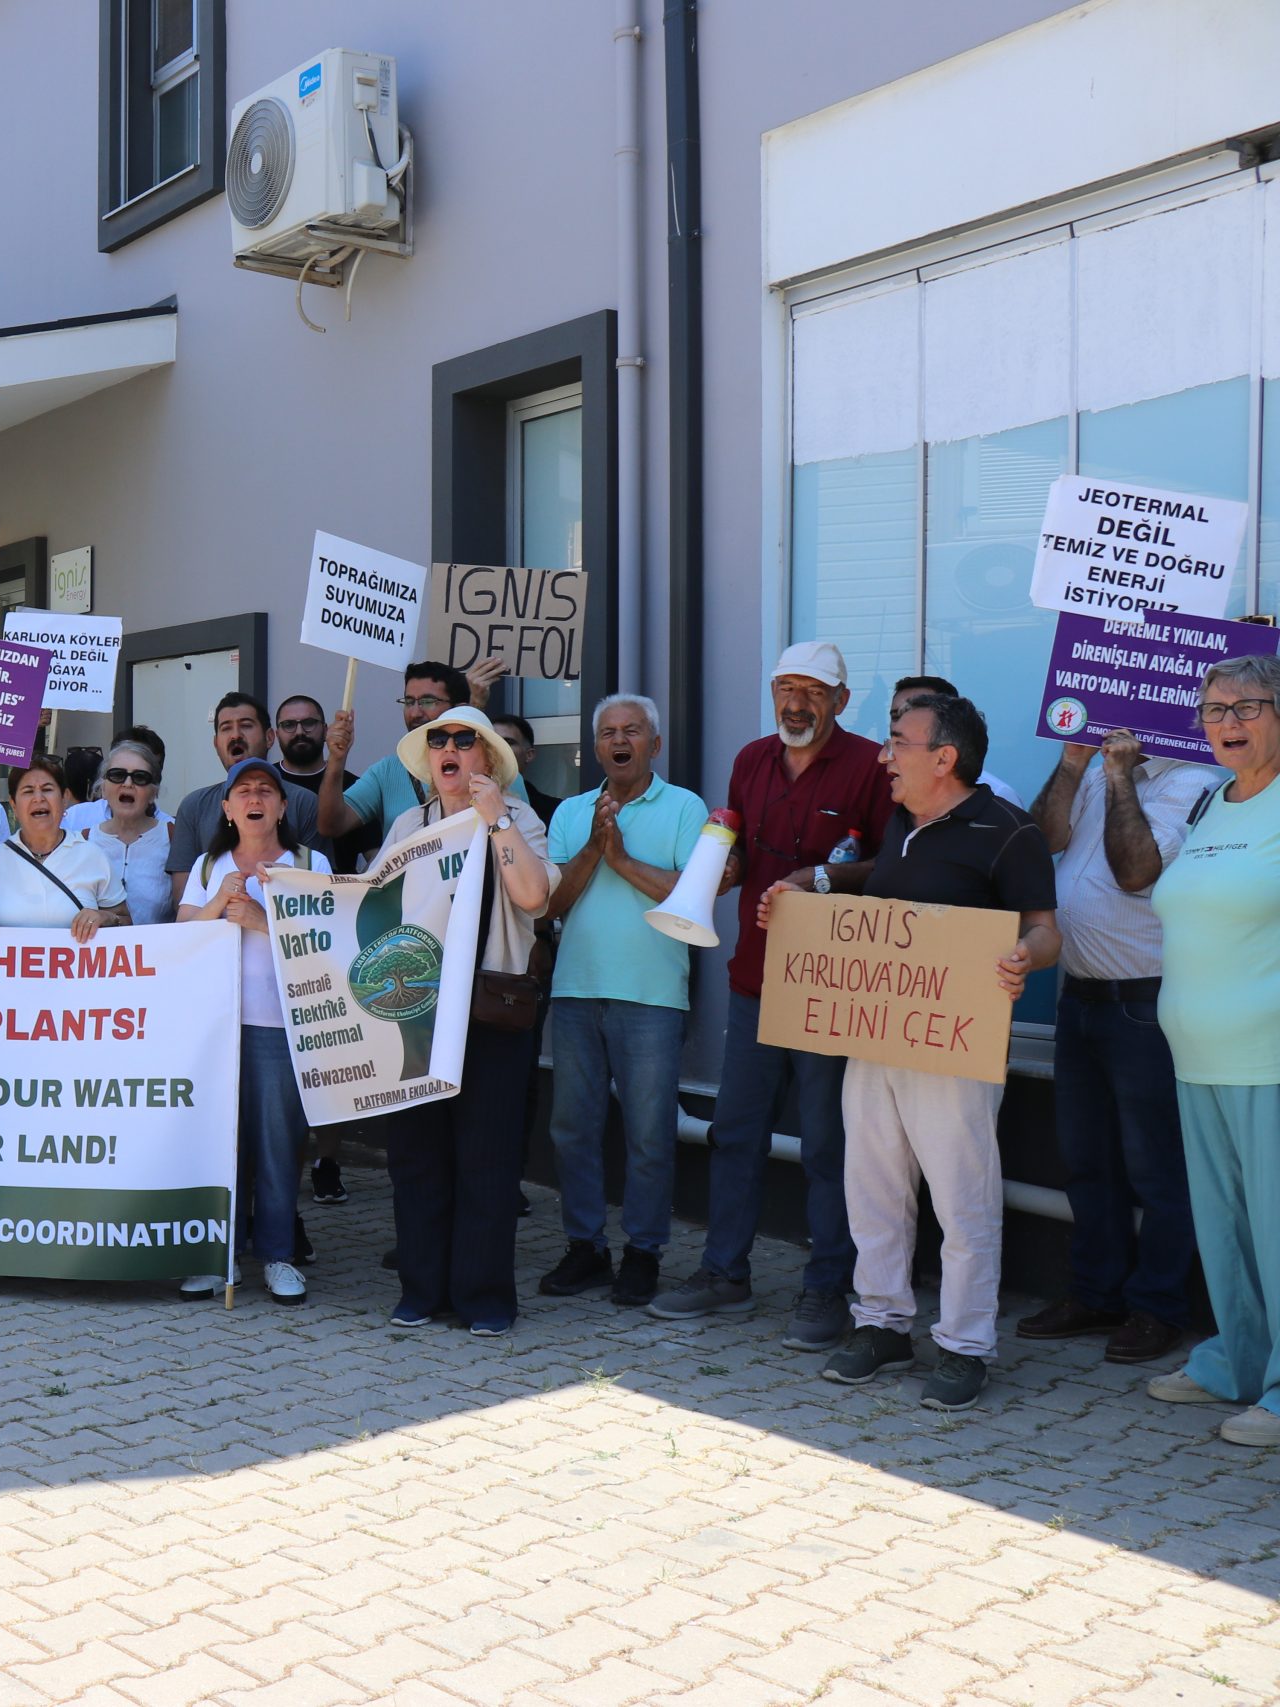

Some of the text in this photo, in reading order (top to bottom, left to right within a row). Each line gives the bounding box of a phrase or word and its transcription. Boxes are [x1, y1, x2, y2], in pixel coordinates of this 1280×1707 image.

[1078, 487, 1210, 523] JEOTERMAL
[1096, 516, 1176, 547] DEĞİL
[1042, 533, 1225, 580] TEMİZ VE DOĞRU
[54, 562, 86, 599] ignis
[319, 556, 417, 604] TOPRAĞIMIZA
[1087, 566, 1166, 594] ENERJİ
[325, 584, 405, 624] SUYUMUZA
[3, 631, 120, 648] KARLIOVA KÖYLER
[321, 608, 395, 645] DOKUNMA
[1103, 619, 1229, 654] DEPREMLE YIKILAN,
[70, 648, 109, 662] DEĞİL
[449, 622, 580, 680] DEFOL
[1072, 639, 1147, 670] DİRENİŞLEN
[1148, 653, 1193, 678] AYAĞA
[49, 678, 88, 693] DİYOR
[1055, 670, 1130, 697] VARTO'DAN
[1155, 735, 1199, 751] DERNEKLERİ
[392, 837, 443, 869] PLATFORMU
[279, 928, 332, 960] Varto
[353, 947, 374, 969] VARTO
[398, 927, 438, 950] PLATFORMU
[287, 973, 332, 999] Santralê
[291, 997, 348, 1026] Elektrîkê
[296, 1023, 364, 1052] Jeotermal
[903, 1010, 974, 1052] ÇEK
[301, 1060, 377, 1090] Nêwazeno!
[73, 1078, 195, 1108] WATER
[353, 1089, 407, 1110] PLATFORMA
[17, 1134, 117, 1165] LAND!
